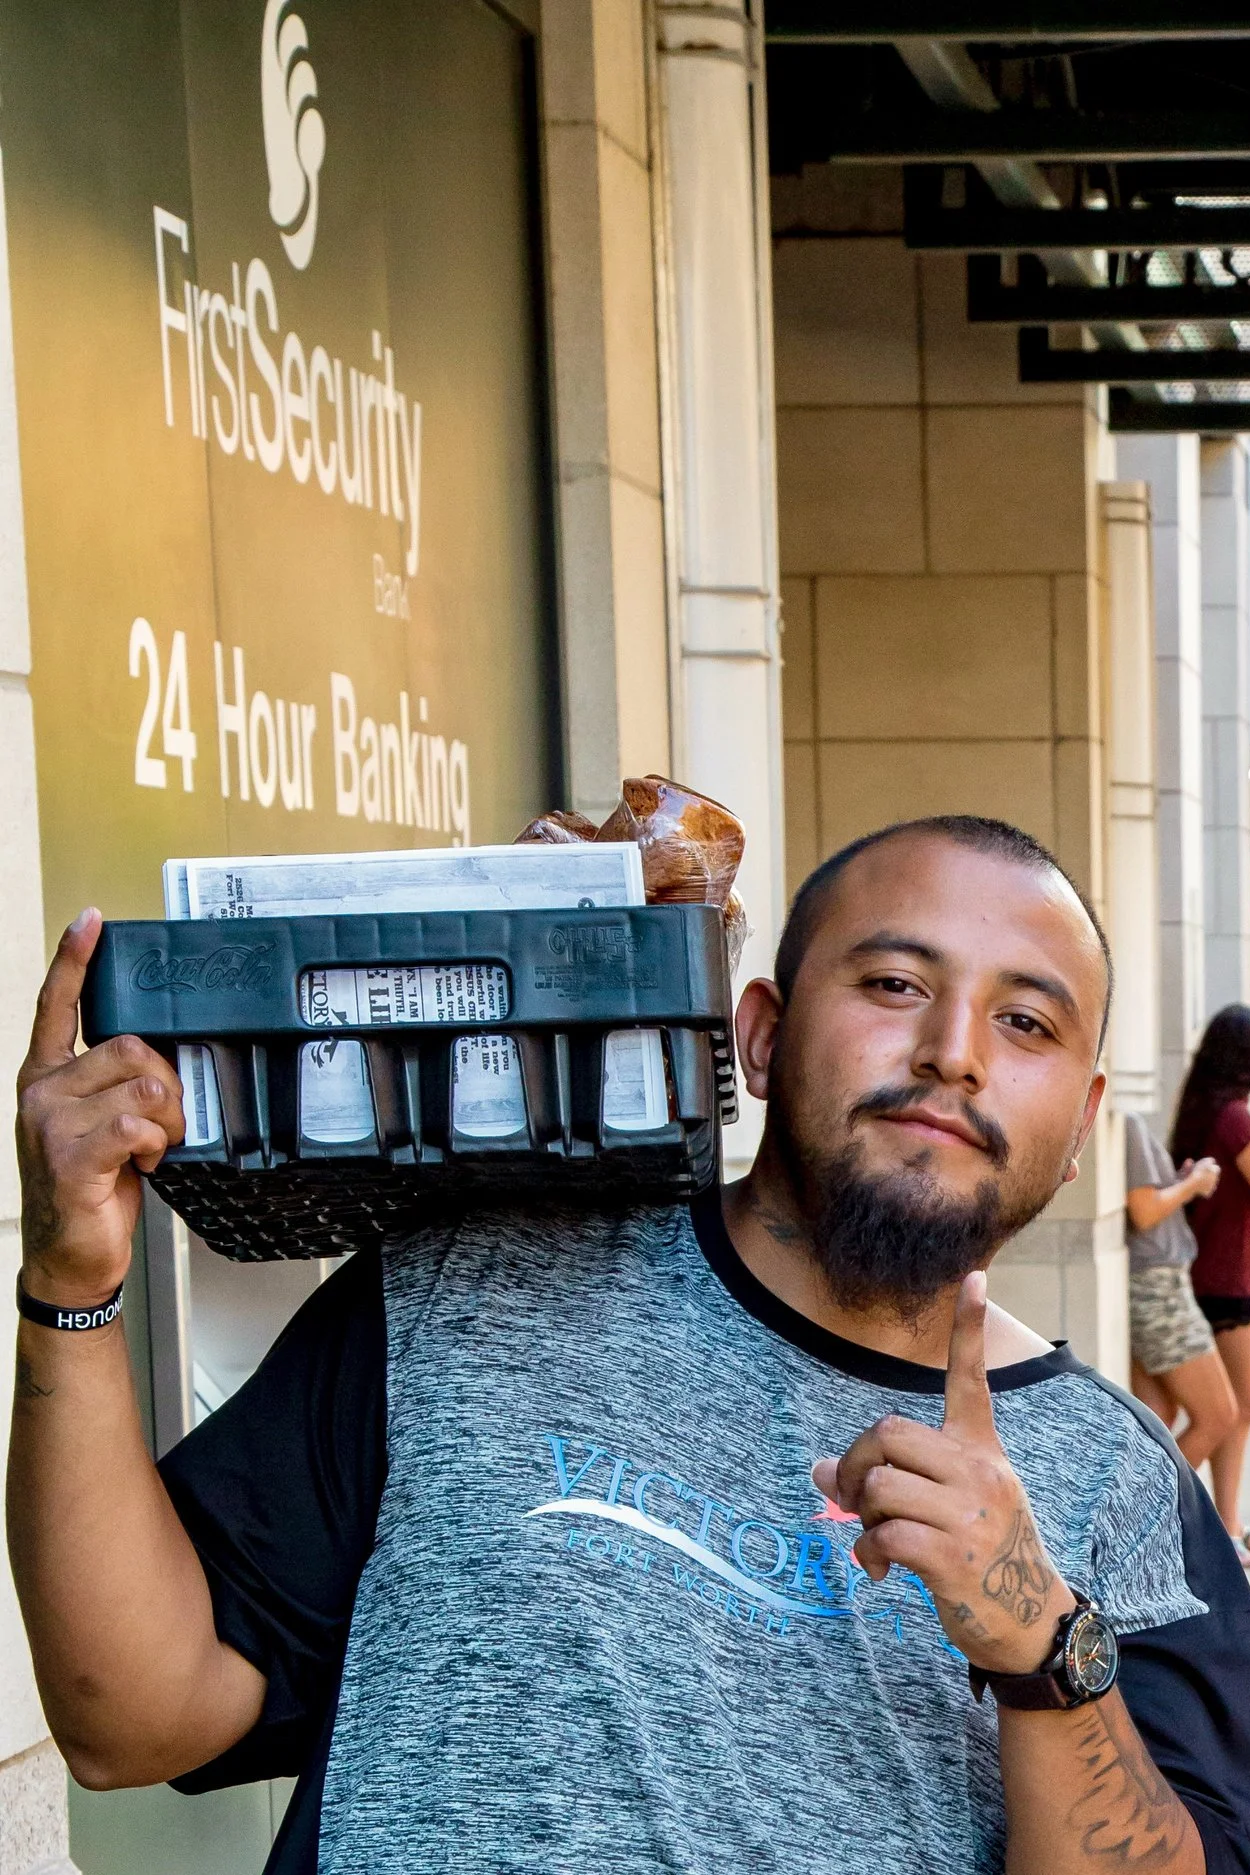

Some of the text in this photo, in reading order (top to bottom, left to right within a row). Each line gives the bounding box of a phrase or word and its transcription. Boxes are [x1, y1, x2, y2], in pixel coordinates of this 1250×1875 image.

[153, 204, 422, 577] FirstSecurity
[129, 616, 470, 849] 24 Hour Banking
[228, 900, 236, 916] Wo
[312, 972, 332, 1026] TORY
[445, 976, 454, 997] and
[454, 971, 465, 1016] you will
[466, 966, 474, 997] ESUS
[476, 966, 485, 1005] nderful
[488, 984, 496, 1010] door
[409, 1001, 419, 1018] AM
[481, 1038, 488, 1048] of
[501, 1050, 509, 1071] you
[544, 1433, 867, 1601] VICTORY
[567, 1528, 791, 1637] FORT WORTH
